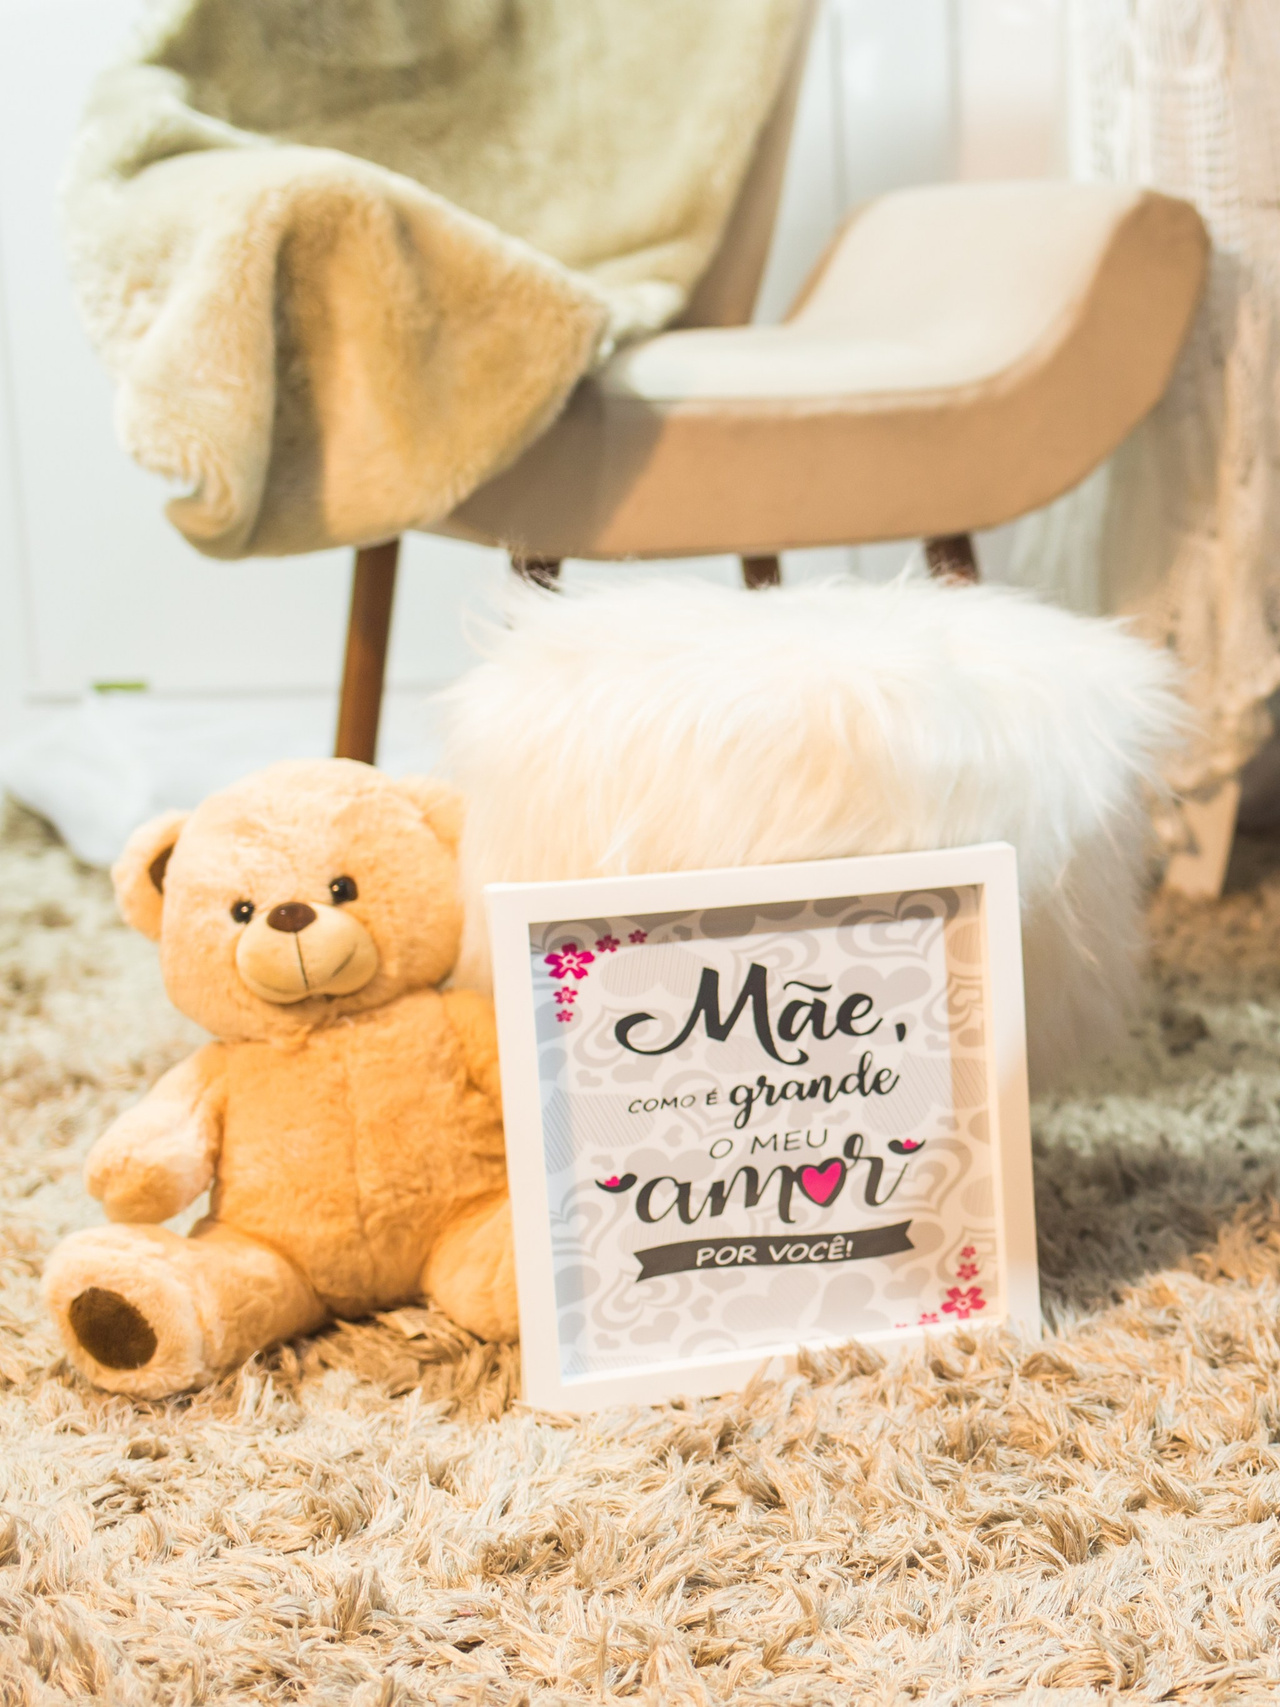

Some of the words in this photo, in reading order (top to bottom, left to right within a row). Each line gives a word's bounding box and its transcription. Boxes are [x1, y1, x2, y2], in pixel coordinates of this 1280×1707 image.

[614, 963, 907, 1066] Mãe,
[628, 1093, 696, 1114] COMO
[705, 1088, 719, 1106] É
[729, 1051, 901, 1129] grande
[635, 1133, 909, 1225] amor
[709, 1138, 734, 1160] O
[750, 1128, 829, 1155] MEU
[696, 1243, 756, 1266] POR
[768, 1236, 854, 1262] VOCÊ!
